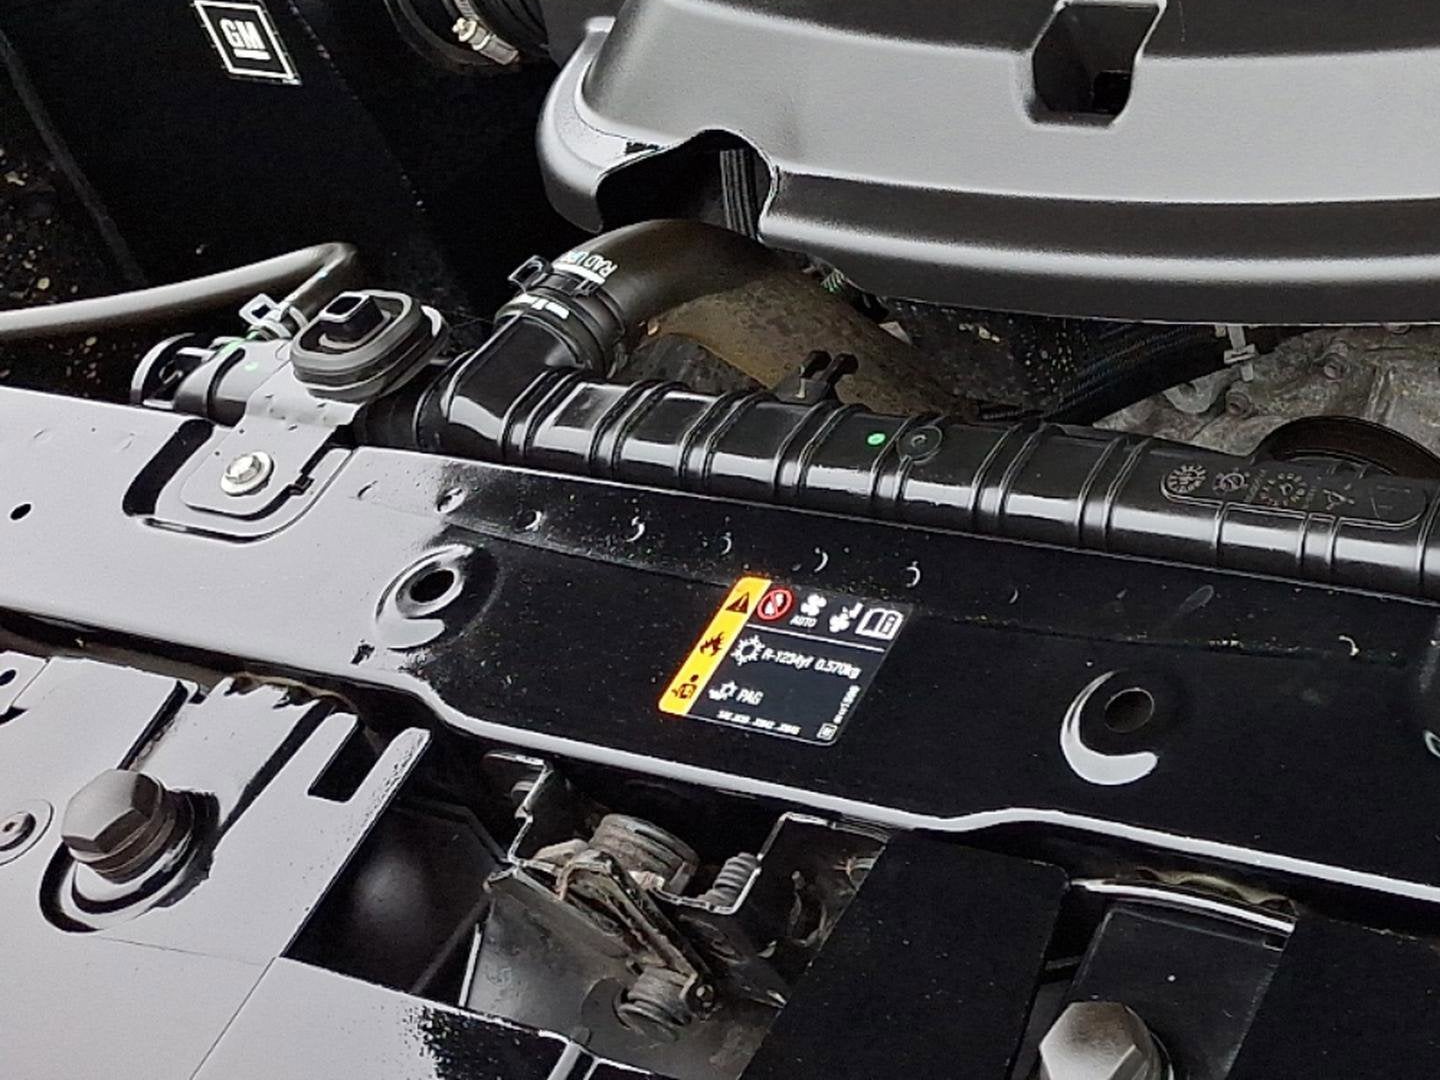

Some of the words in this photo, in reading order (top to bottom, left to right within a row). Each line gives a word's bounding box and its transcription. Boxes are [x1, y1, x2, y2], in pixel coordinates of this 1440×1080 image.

[219, 18, 266, 49] GM
[789, 615, 816, 628] AUTO
[736, 689, 764, 705] PAG
